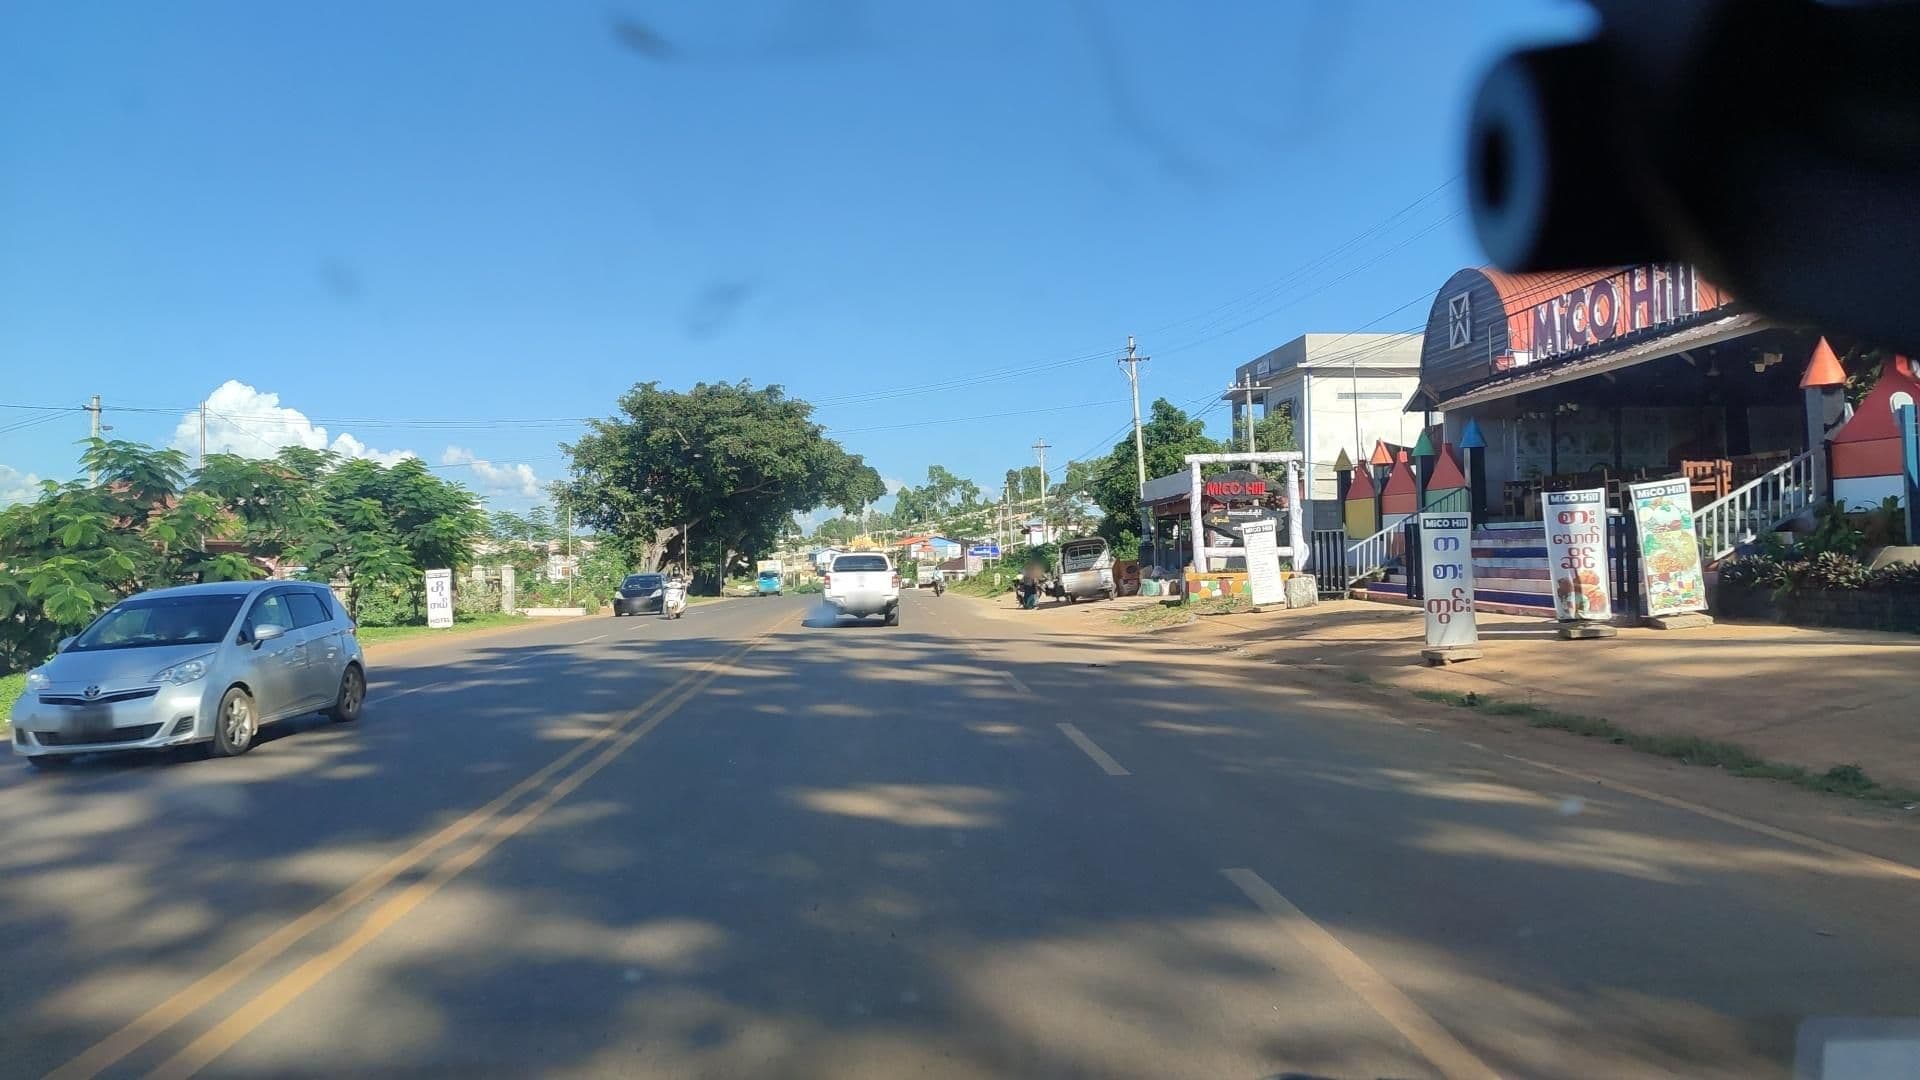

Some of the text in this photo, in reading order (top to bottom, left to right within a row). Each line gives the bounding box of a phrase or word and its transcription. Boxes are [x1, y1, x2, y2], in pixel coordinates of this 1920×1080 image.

[1557, 510, 1596, 525] စား
[1552, 525, 1600, 545] သောက်
[1432, 563, 1464, 580] စား
[1427, 587, 1471, 625] ကွင်း
